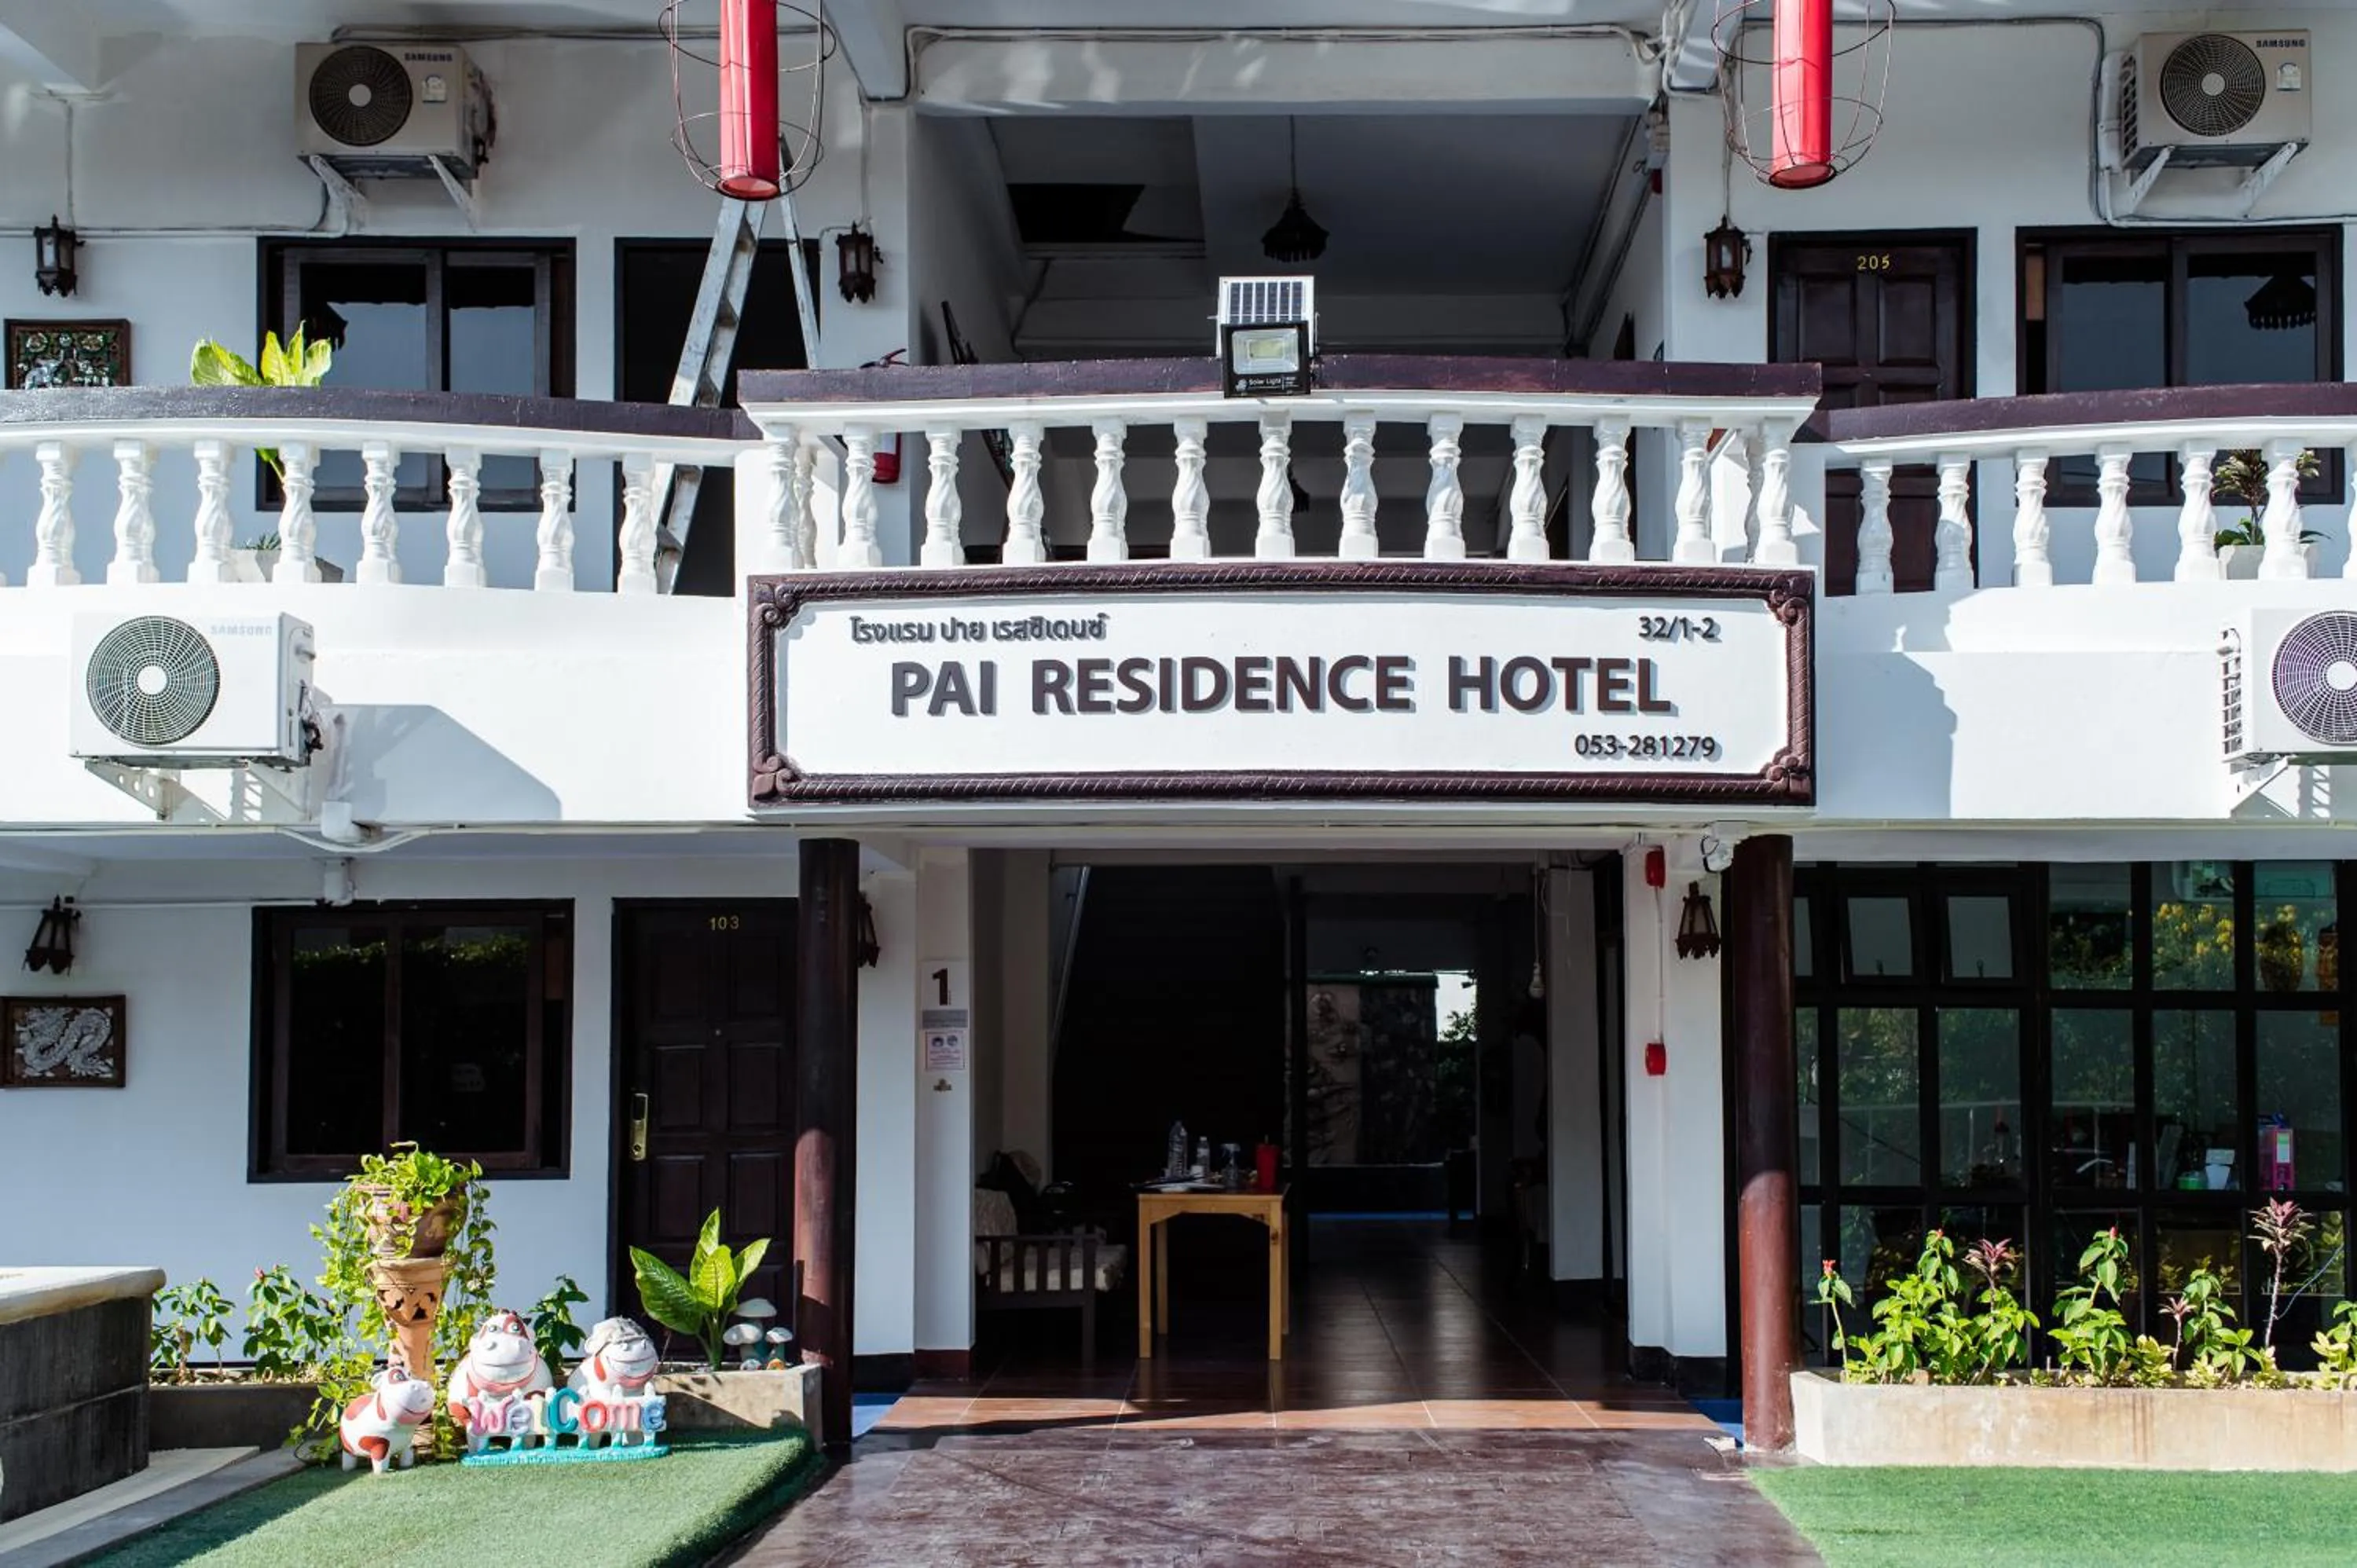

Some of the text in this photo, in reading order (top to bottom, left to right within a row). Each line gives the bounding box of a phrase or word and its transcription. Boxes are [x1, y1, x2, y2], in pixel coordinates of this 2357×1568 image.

[2256, 38, 2306, 48] SAMSUNG
[404, 53, 453, 62] SAMSUNG
[1857, 254, 1890, 270] 205
[210, 625, 273, 636] SAMSUNG
[849, 616, 933, 642] โรงแรม
[940, 616, 986, 641] ปาย
[1638, 616, 1717, 639] 32/1-2
[892, 655, 1673, 716] PAI RESIDENCE HOTEL
[1574, 734, 1717, 759] 053-281279
[709, 915, 739, 931] 103
[932, 967, 948, 1006] 1
